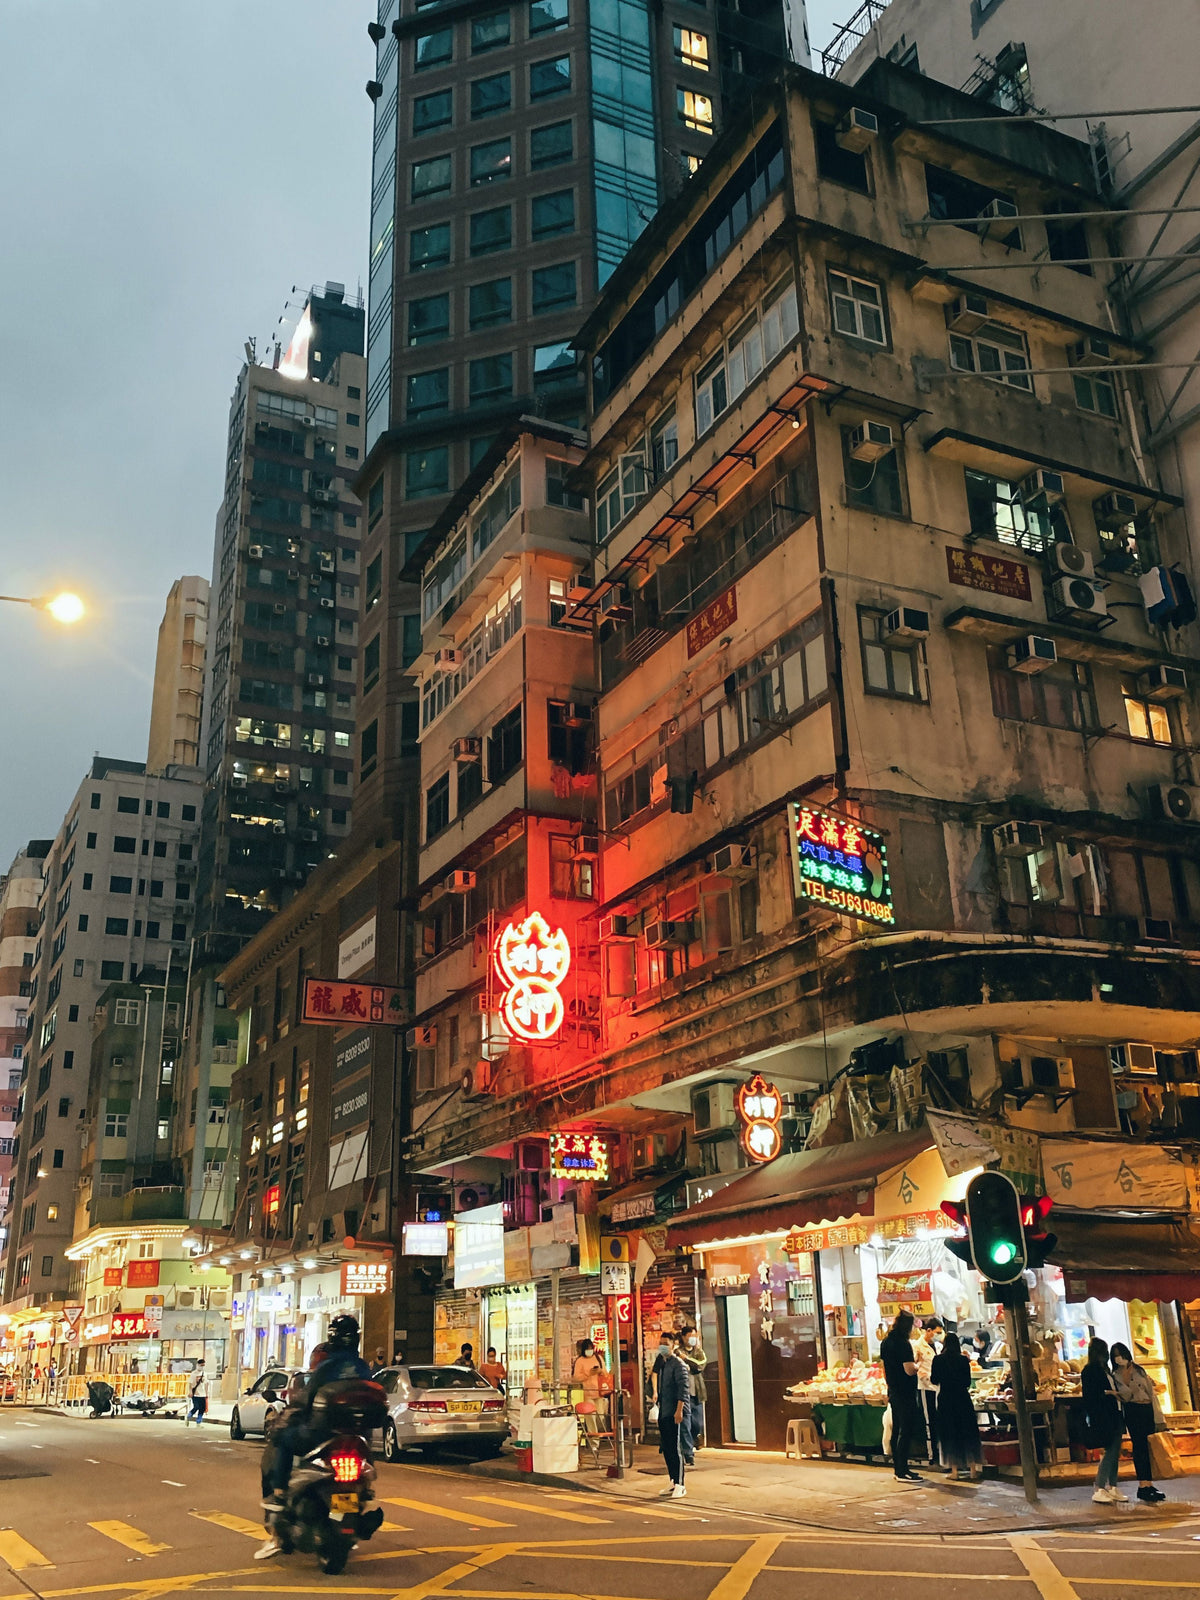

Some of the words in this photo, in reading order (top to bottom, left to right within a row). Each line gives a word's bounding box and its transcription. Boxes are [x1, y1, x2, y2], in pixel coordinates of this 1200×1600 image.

[796, 810, 861, 856] 足滿堂
[863, 898, 892, 921] 0898
[310, 985, 367, 1018] 龍威
[513, 982, 555, 1034] 押
[786, 1229, 823, 1252] 日本技術
[827, 1225, 868, 1247] 香港首家
